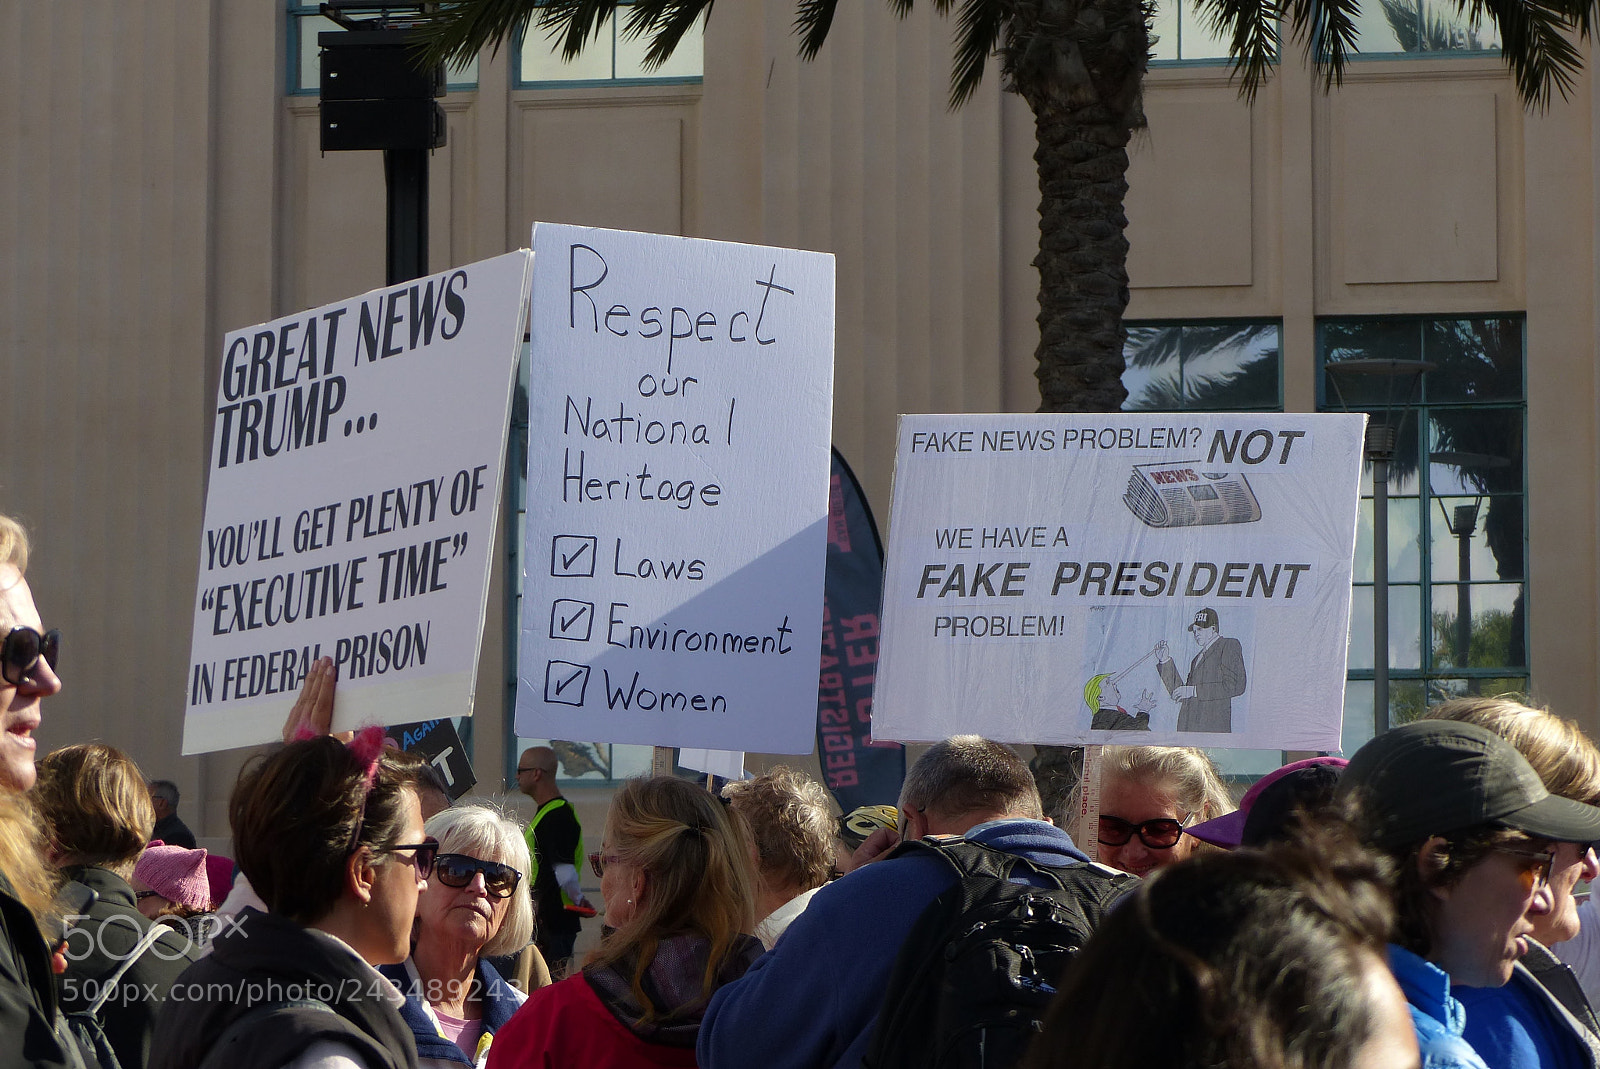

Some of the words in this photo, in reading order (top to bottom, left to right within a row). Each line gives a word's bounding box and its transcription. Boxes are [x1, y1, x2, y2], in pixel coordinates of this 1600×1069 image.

[570, 243, 795, 374] Respect
[222, 307, 347, 402] GREAT
[354, 270, 468, 367] NEWS
[638, 373, 698, 397] our
[563, 394, 736, 446] National
[911, 431, 974, 453] FAKE
[980, 429, 1056, 452] NEWS
[1062, 427, 1203, 450] PROBLEM?
[1206, 429, 1306, 465] NOT
[562, 447, 722, 510] Heritage
[1150, 468, 1200, 485] NEWS
[293, 502, 342, 555] GET
[346, 476, 445, 542] PLENTY
[450, 464, 488, 517] OF
[614, 538, 706, 580] Laws
[935, 529, 975, 550] WE
[981, 527, 1047, 549] HAVE
[1053, 526, 1070, 548] A
[916, 563, 1031, 599] FAKE
[1051, 562, 1311, 599] PRESIDENT
[607, 602, 793, 655] Environment
[934, 616, 1065, 637] PROBLEM!
[191, 661, 217, 706] IN
[334, 620, 431, 683] PRISON
[603, 669, 728, 713] Women
[403, 719, 444, 752] AGAI
